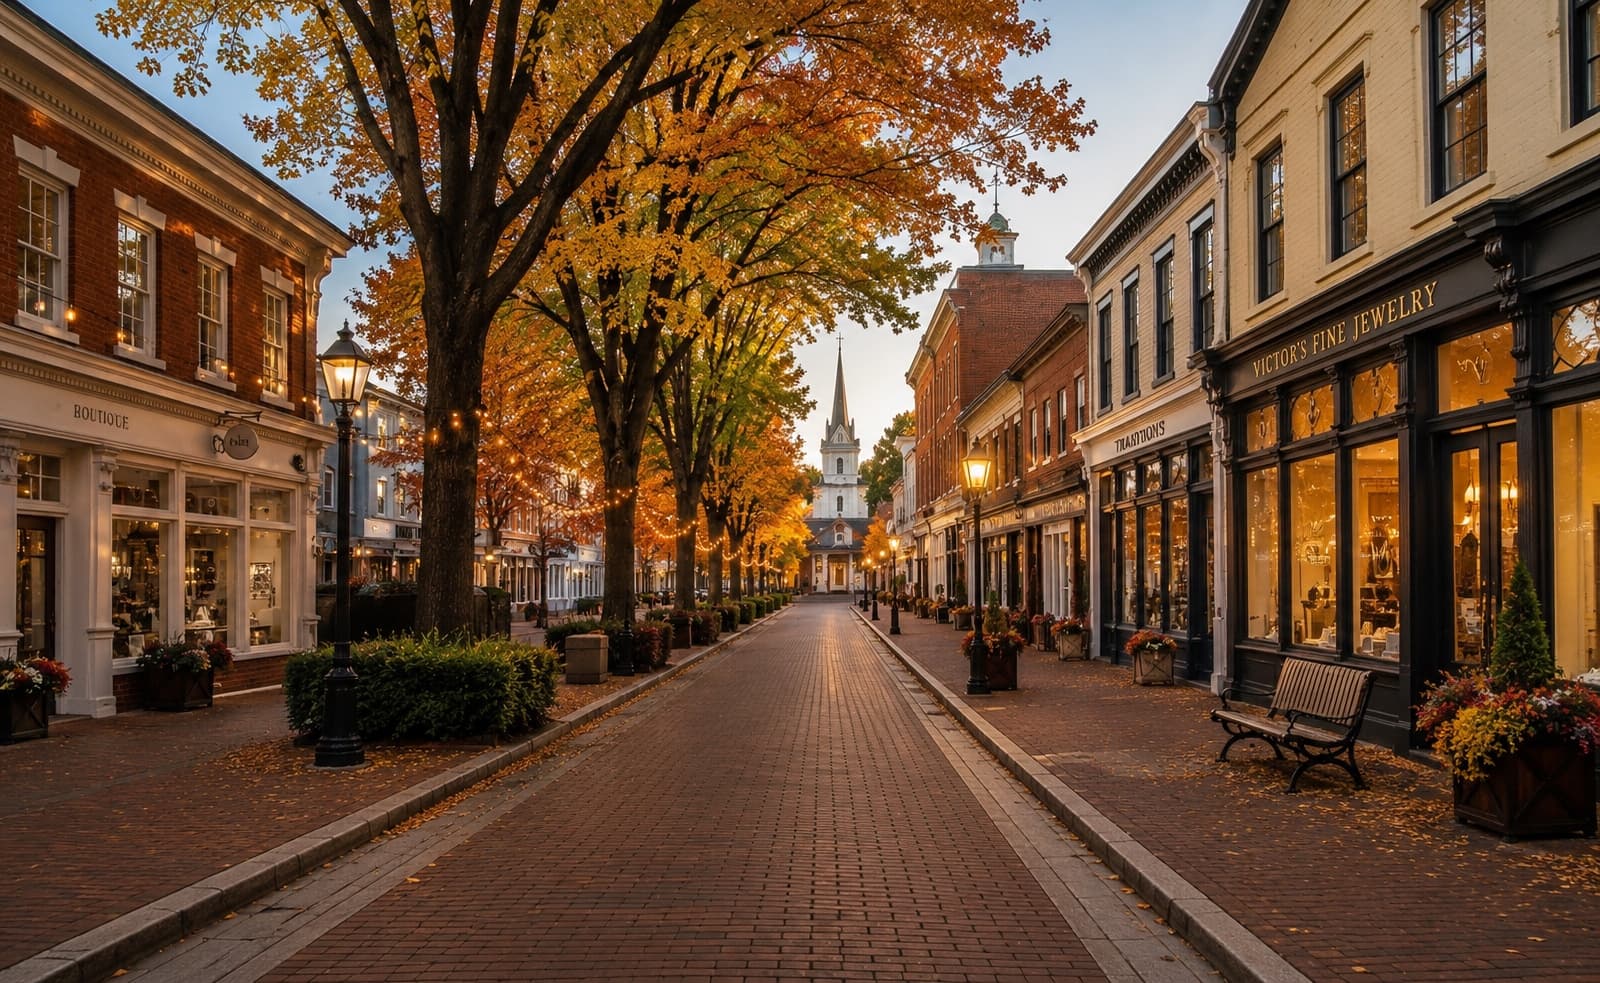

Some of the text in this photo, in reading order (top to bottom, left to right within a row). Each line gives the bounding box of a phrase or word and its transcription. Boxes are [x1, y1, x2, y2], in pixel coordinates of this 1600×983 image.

[1253, 281, 1439, 378] VICTOR'S FINE JEWELRY
